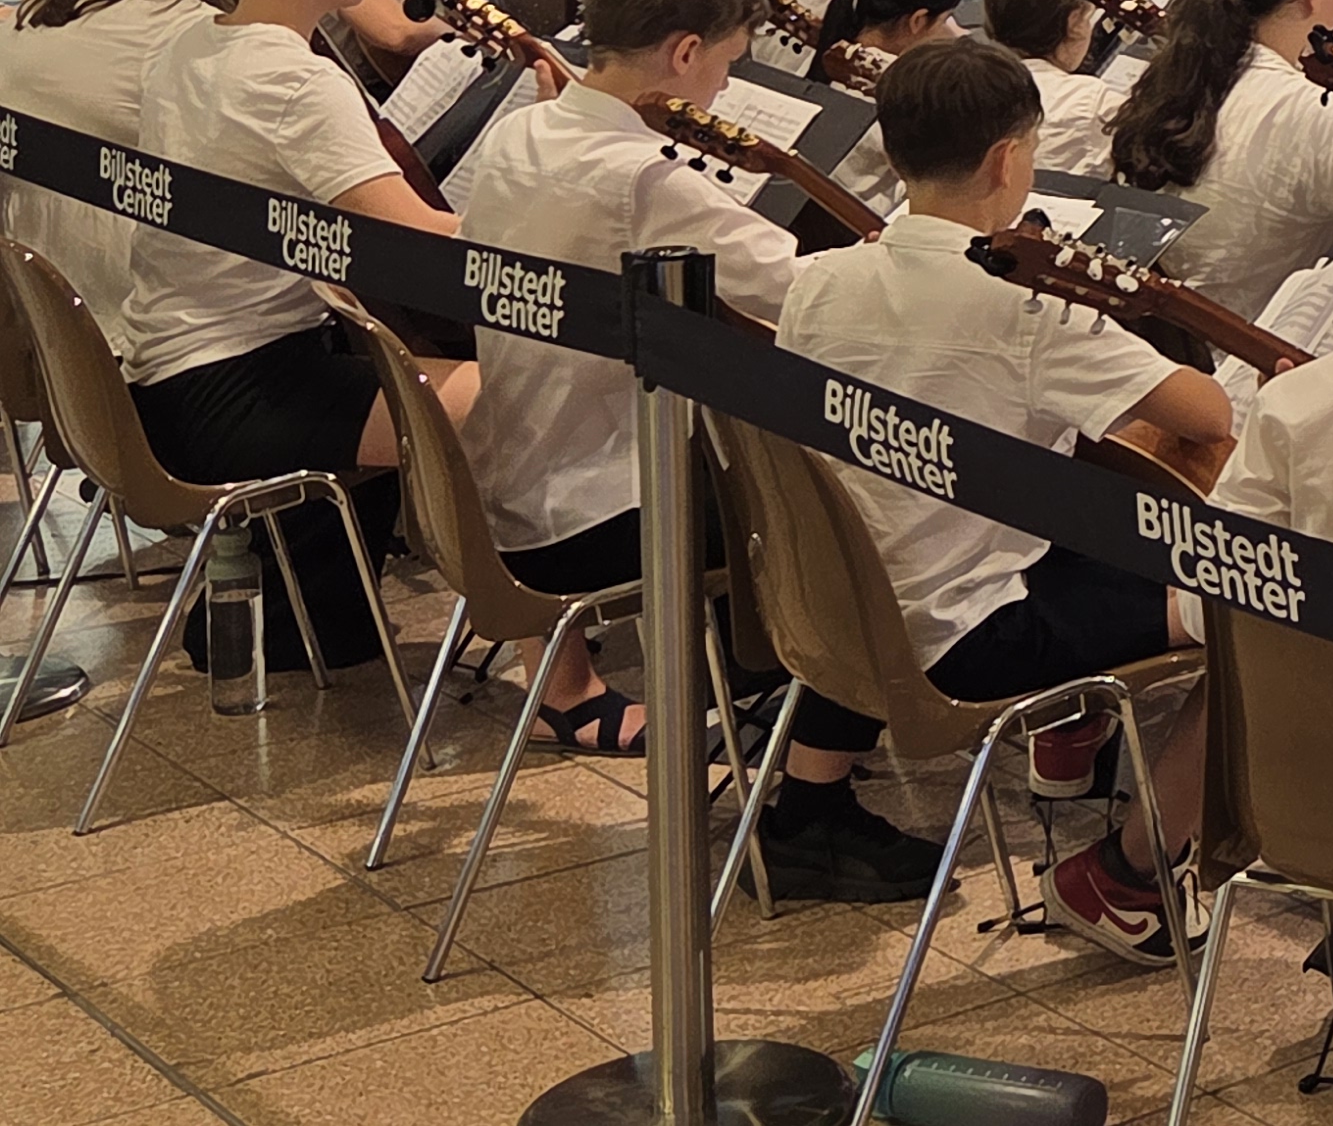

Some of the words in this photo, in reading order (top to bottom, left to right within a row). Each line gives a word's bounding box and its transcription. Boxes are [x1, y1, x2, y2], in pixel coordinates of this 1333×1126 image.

[99, 147, 173, 200] Billstedt
[112, 182, 173, 227] Center
[267, 197, 352, 255] Billstedt
[281, 227, 352, 282] Center
[464, 249, 566, 308] Billstedt
[480, 284, 565, 339] Center
[824, 379, 954, 468] Billstedt
[849, 419, 957, 500] Center
[1136, 492, 1302, 587] Billstedt
[1170, 535, 1306, 623] Center
